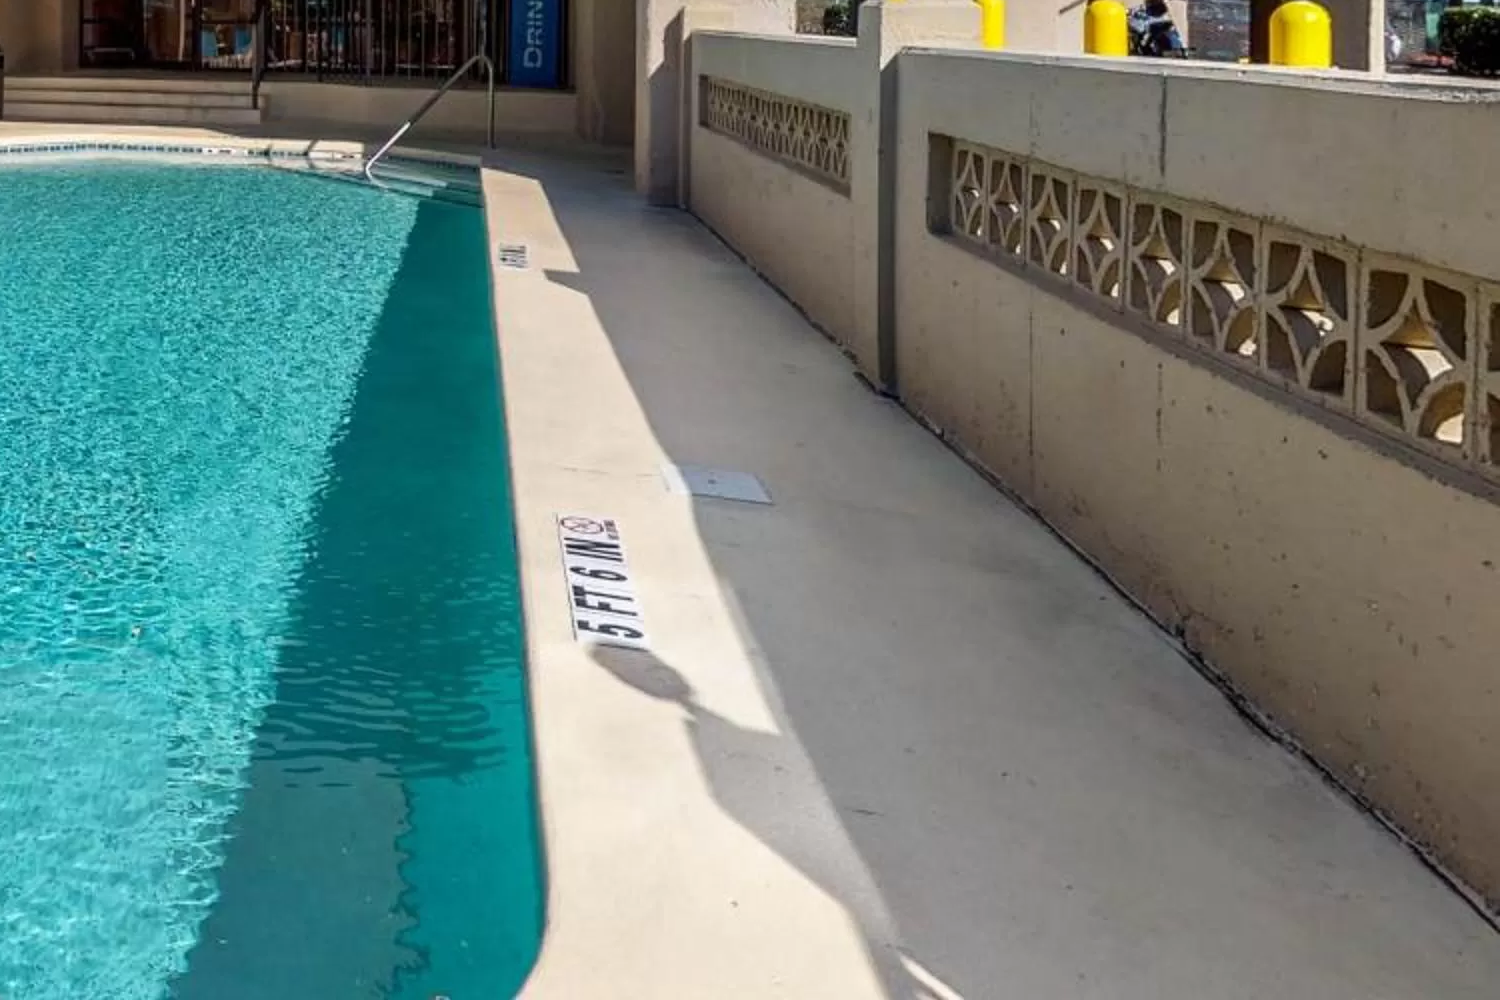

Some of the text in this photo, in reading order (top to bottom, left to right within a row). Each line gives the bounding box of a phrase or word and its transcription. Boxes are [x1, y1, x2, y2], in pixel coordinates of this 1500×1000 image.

[563, 537, 644, 639] 5 FT 6 IN
